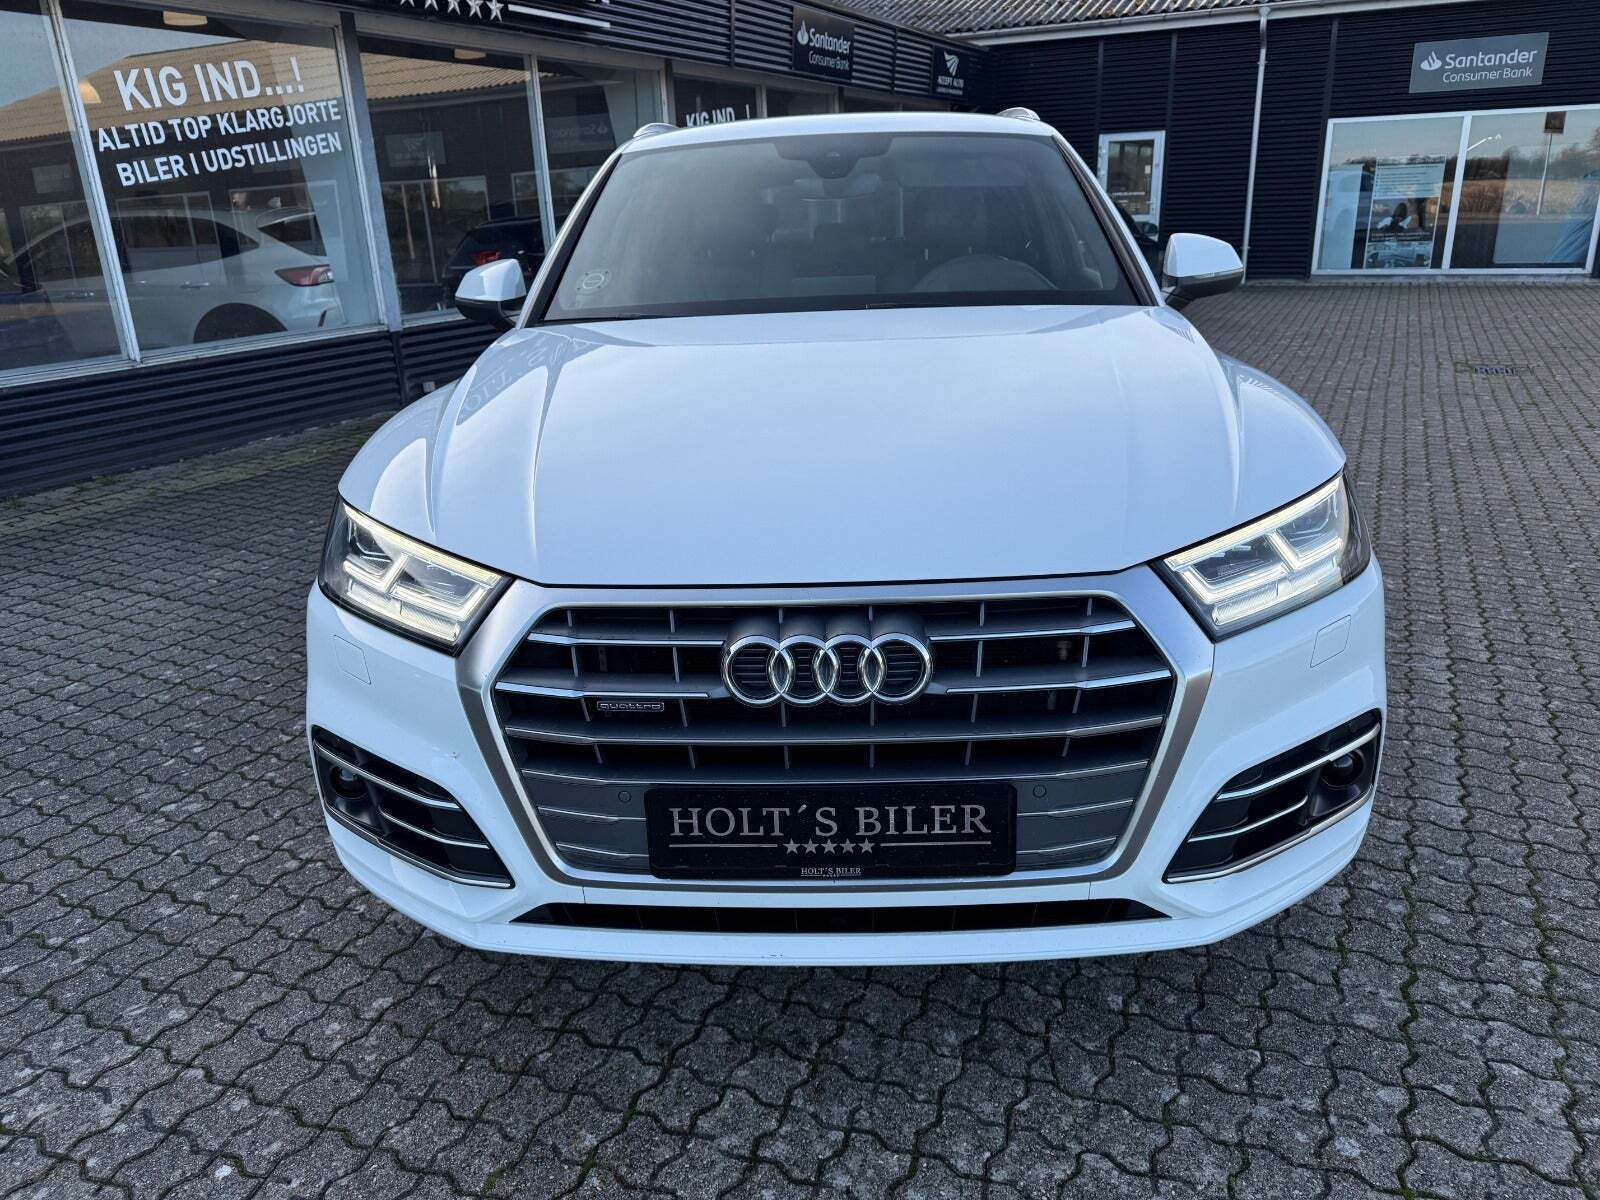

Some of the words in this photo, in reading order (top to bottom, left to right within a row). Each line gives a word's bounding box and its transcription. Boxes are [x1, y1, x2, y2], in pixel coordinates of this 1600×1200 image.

[809, 28, 850, 53] Santander
[808, 51, 836, 67] Consumer
[836, 57, 849, 70] Bank
[1444, 48, 1538, 69] Santander
[112, 65, 188, 112] KIG
[1442, 69, 1502, 83] Consumer
[1503, 66, 1533, 79] Bank
[98, 121, 166, 152] ALTID
[168, 115, 212, 142] TOP
[215, 100, 342, 136] KLARGJORTE
[116, 155, 189, 187] BILER
[190, 153, 200, 175] I
[201, 132, 342, 173] UDSTILLINGEN
[854, 804, 992, 836] BILER
